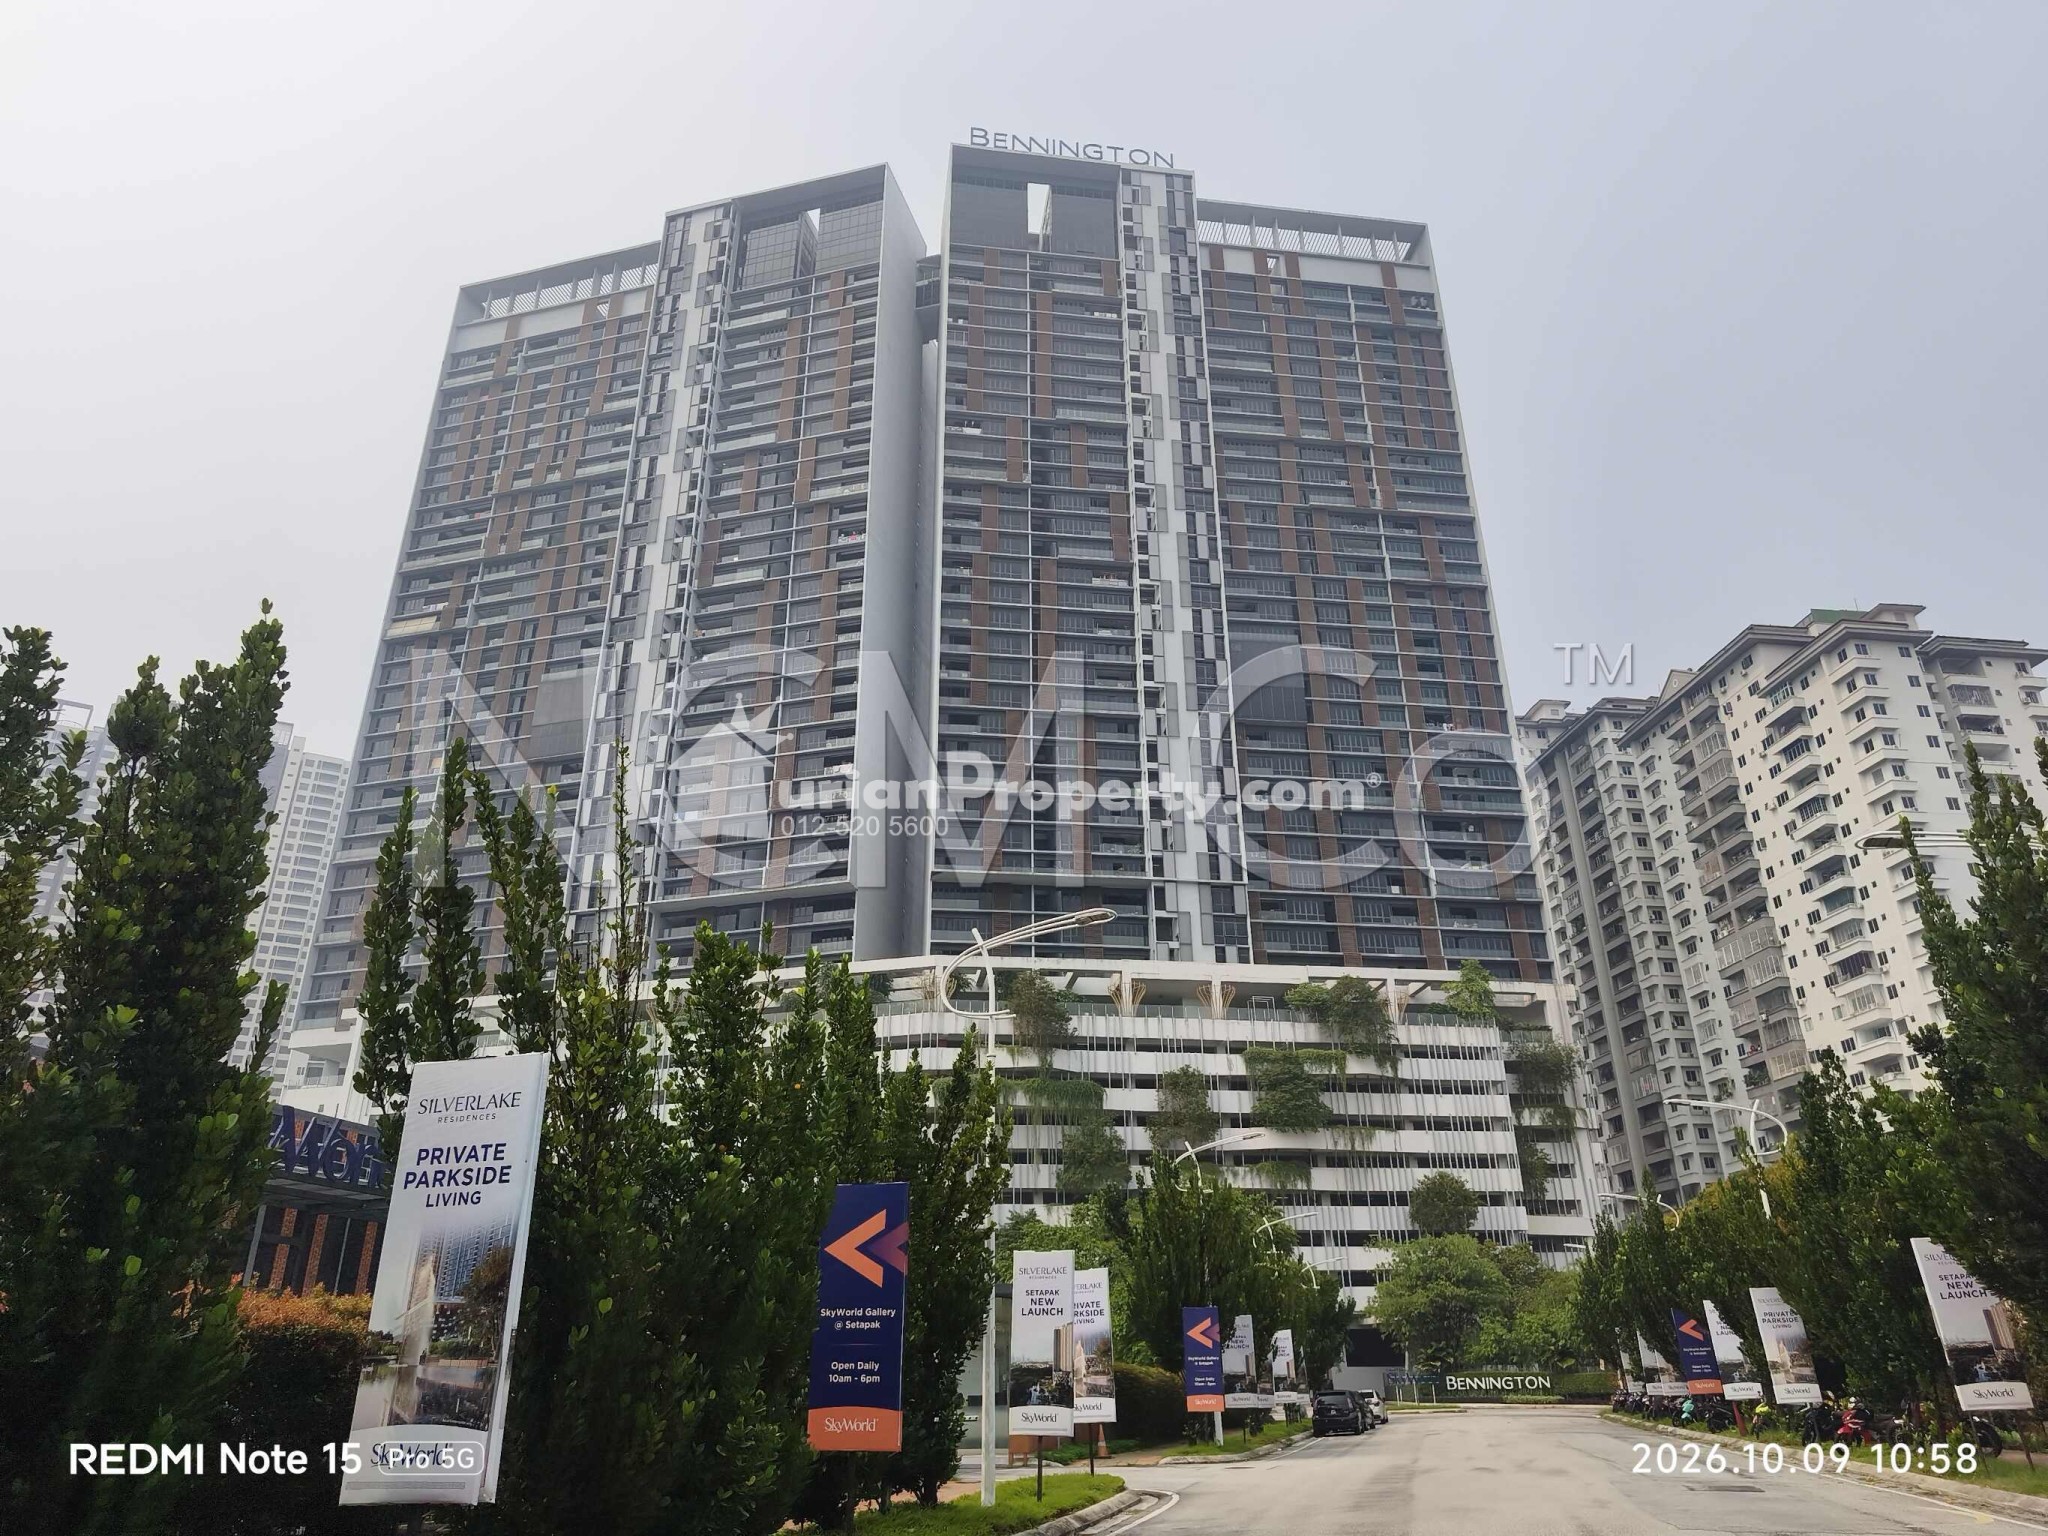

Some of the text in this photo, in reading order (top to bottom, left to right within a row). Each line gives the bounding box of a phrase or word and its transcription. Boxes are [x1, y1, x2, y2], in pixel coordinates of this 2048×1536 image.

[969, 126, 1175, 169] BENNINGTON
[418, 1091, 522, 1115] SILVERLAKE
[438, 1112, 497, 1124] RESIDENCES
[416, 1142, 507, 1166] PRIVATE
[403, 1165, 512, 1190] PARKSIDE
[425, 1190, 482, 1208] LIVING
[1018, 1266, 1068, 1276] SILVERLAKE
[1946, 1281, 1974, 1290] NEW
[1025, 1289, 1060, 1297] SETAPAK
[1940, 1290, 1988, 1300] LAUNCH
[1030, 1297, 1055, 1306] NEW
[820, 1307, 896, 1318] SkyWorld Gallery
[1021, 1307, 1064, 1316] LAUNCH
[1073, 1308, 1105, 1318] RKSIDE
[834, 1320, 881, 1330] @ Setapak
[831, 1361, 880, 1371] Open Daily
[829, 1374, 852, 1383] 10am
[860, 1374, 881, 1384] 6pm
[1445, 1375, 1551, 1391] BENNINGTON
[1784, 1387, 1812, 1395] SkyWorld
[1973, 1389, 2015, 1400] SkyWorld
[1021, 1412, 1058, 1423] SkyWorld
[824, 1417, 879, 1434] SkyWorld
